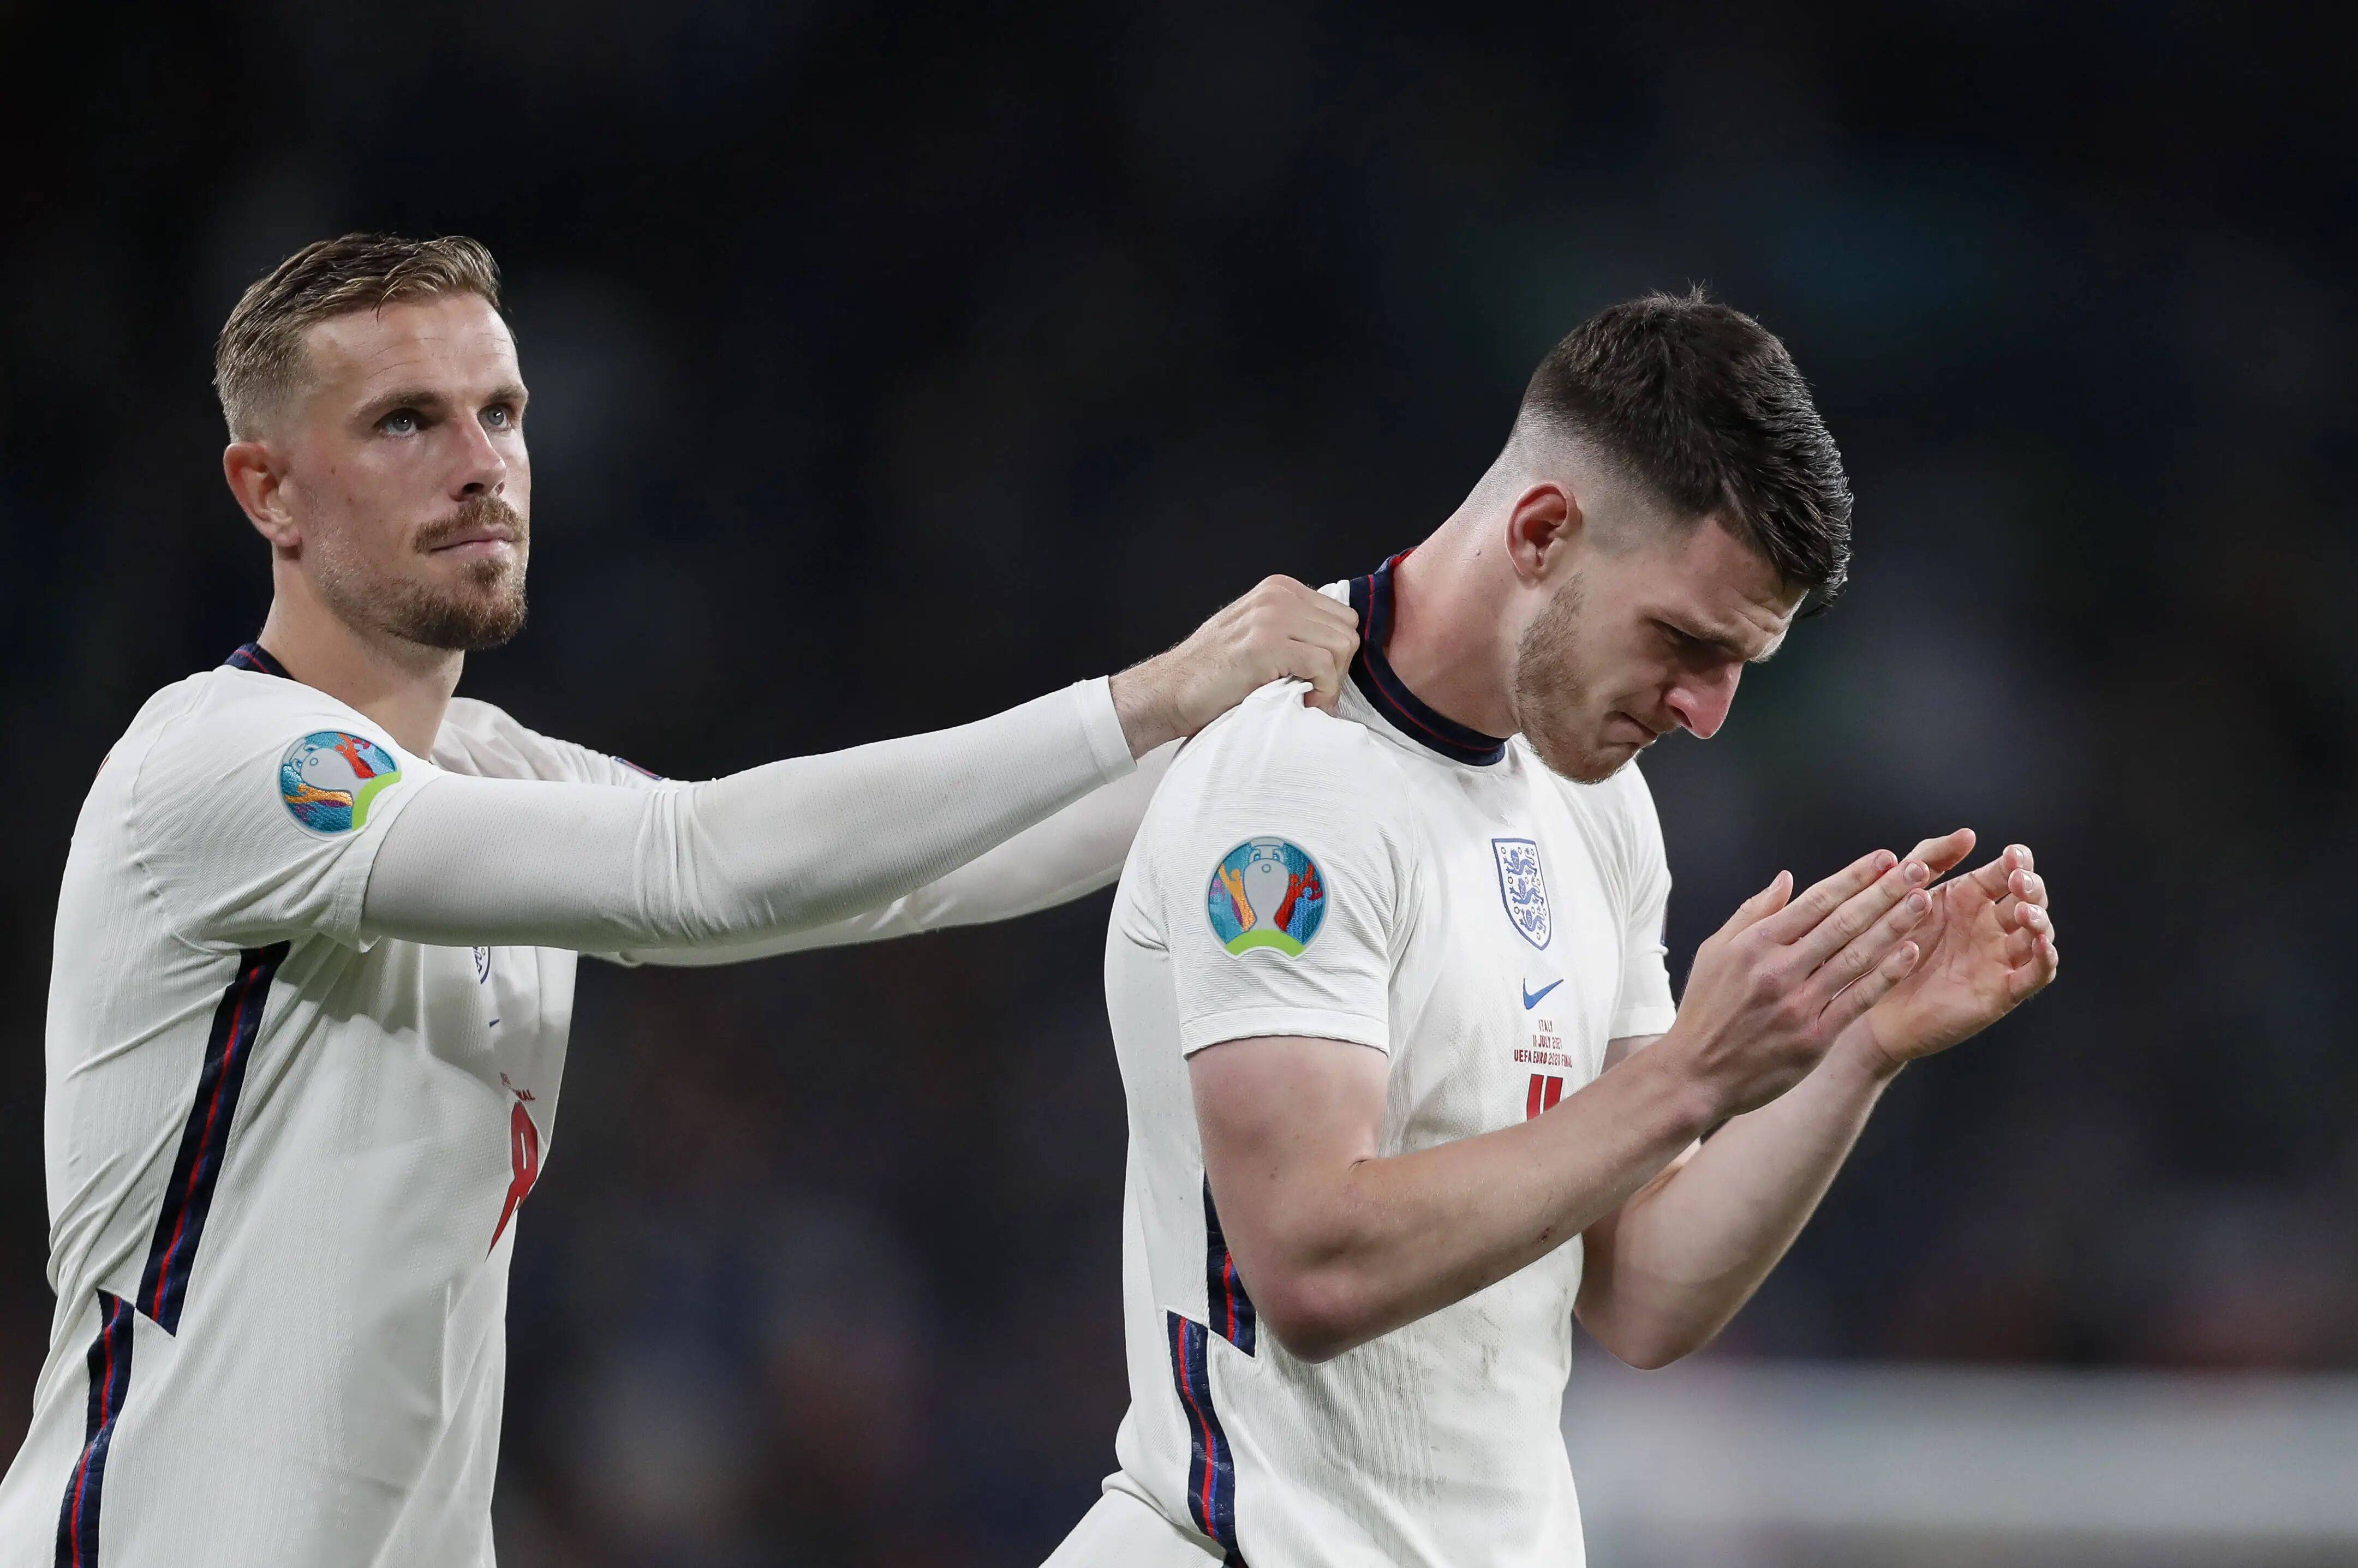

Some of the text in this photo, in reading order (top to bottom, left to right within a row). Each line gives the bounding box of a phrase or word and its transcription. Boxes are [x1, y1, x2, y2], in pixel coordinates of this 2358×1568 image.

[1538, 1019, 1553, 1033] ITALY
[1532, 1034, 1537, 1048] 11
[1538, 1035, 1551, 1049] JULY
[1514, 1049, 1532, 1063] UEFA
[1533, 1051, 1548, 1064] EURO
[1548, 1052, 1560, 1066] 2020
